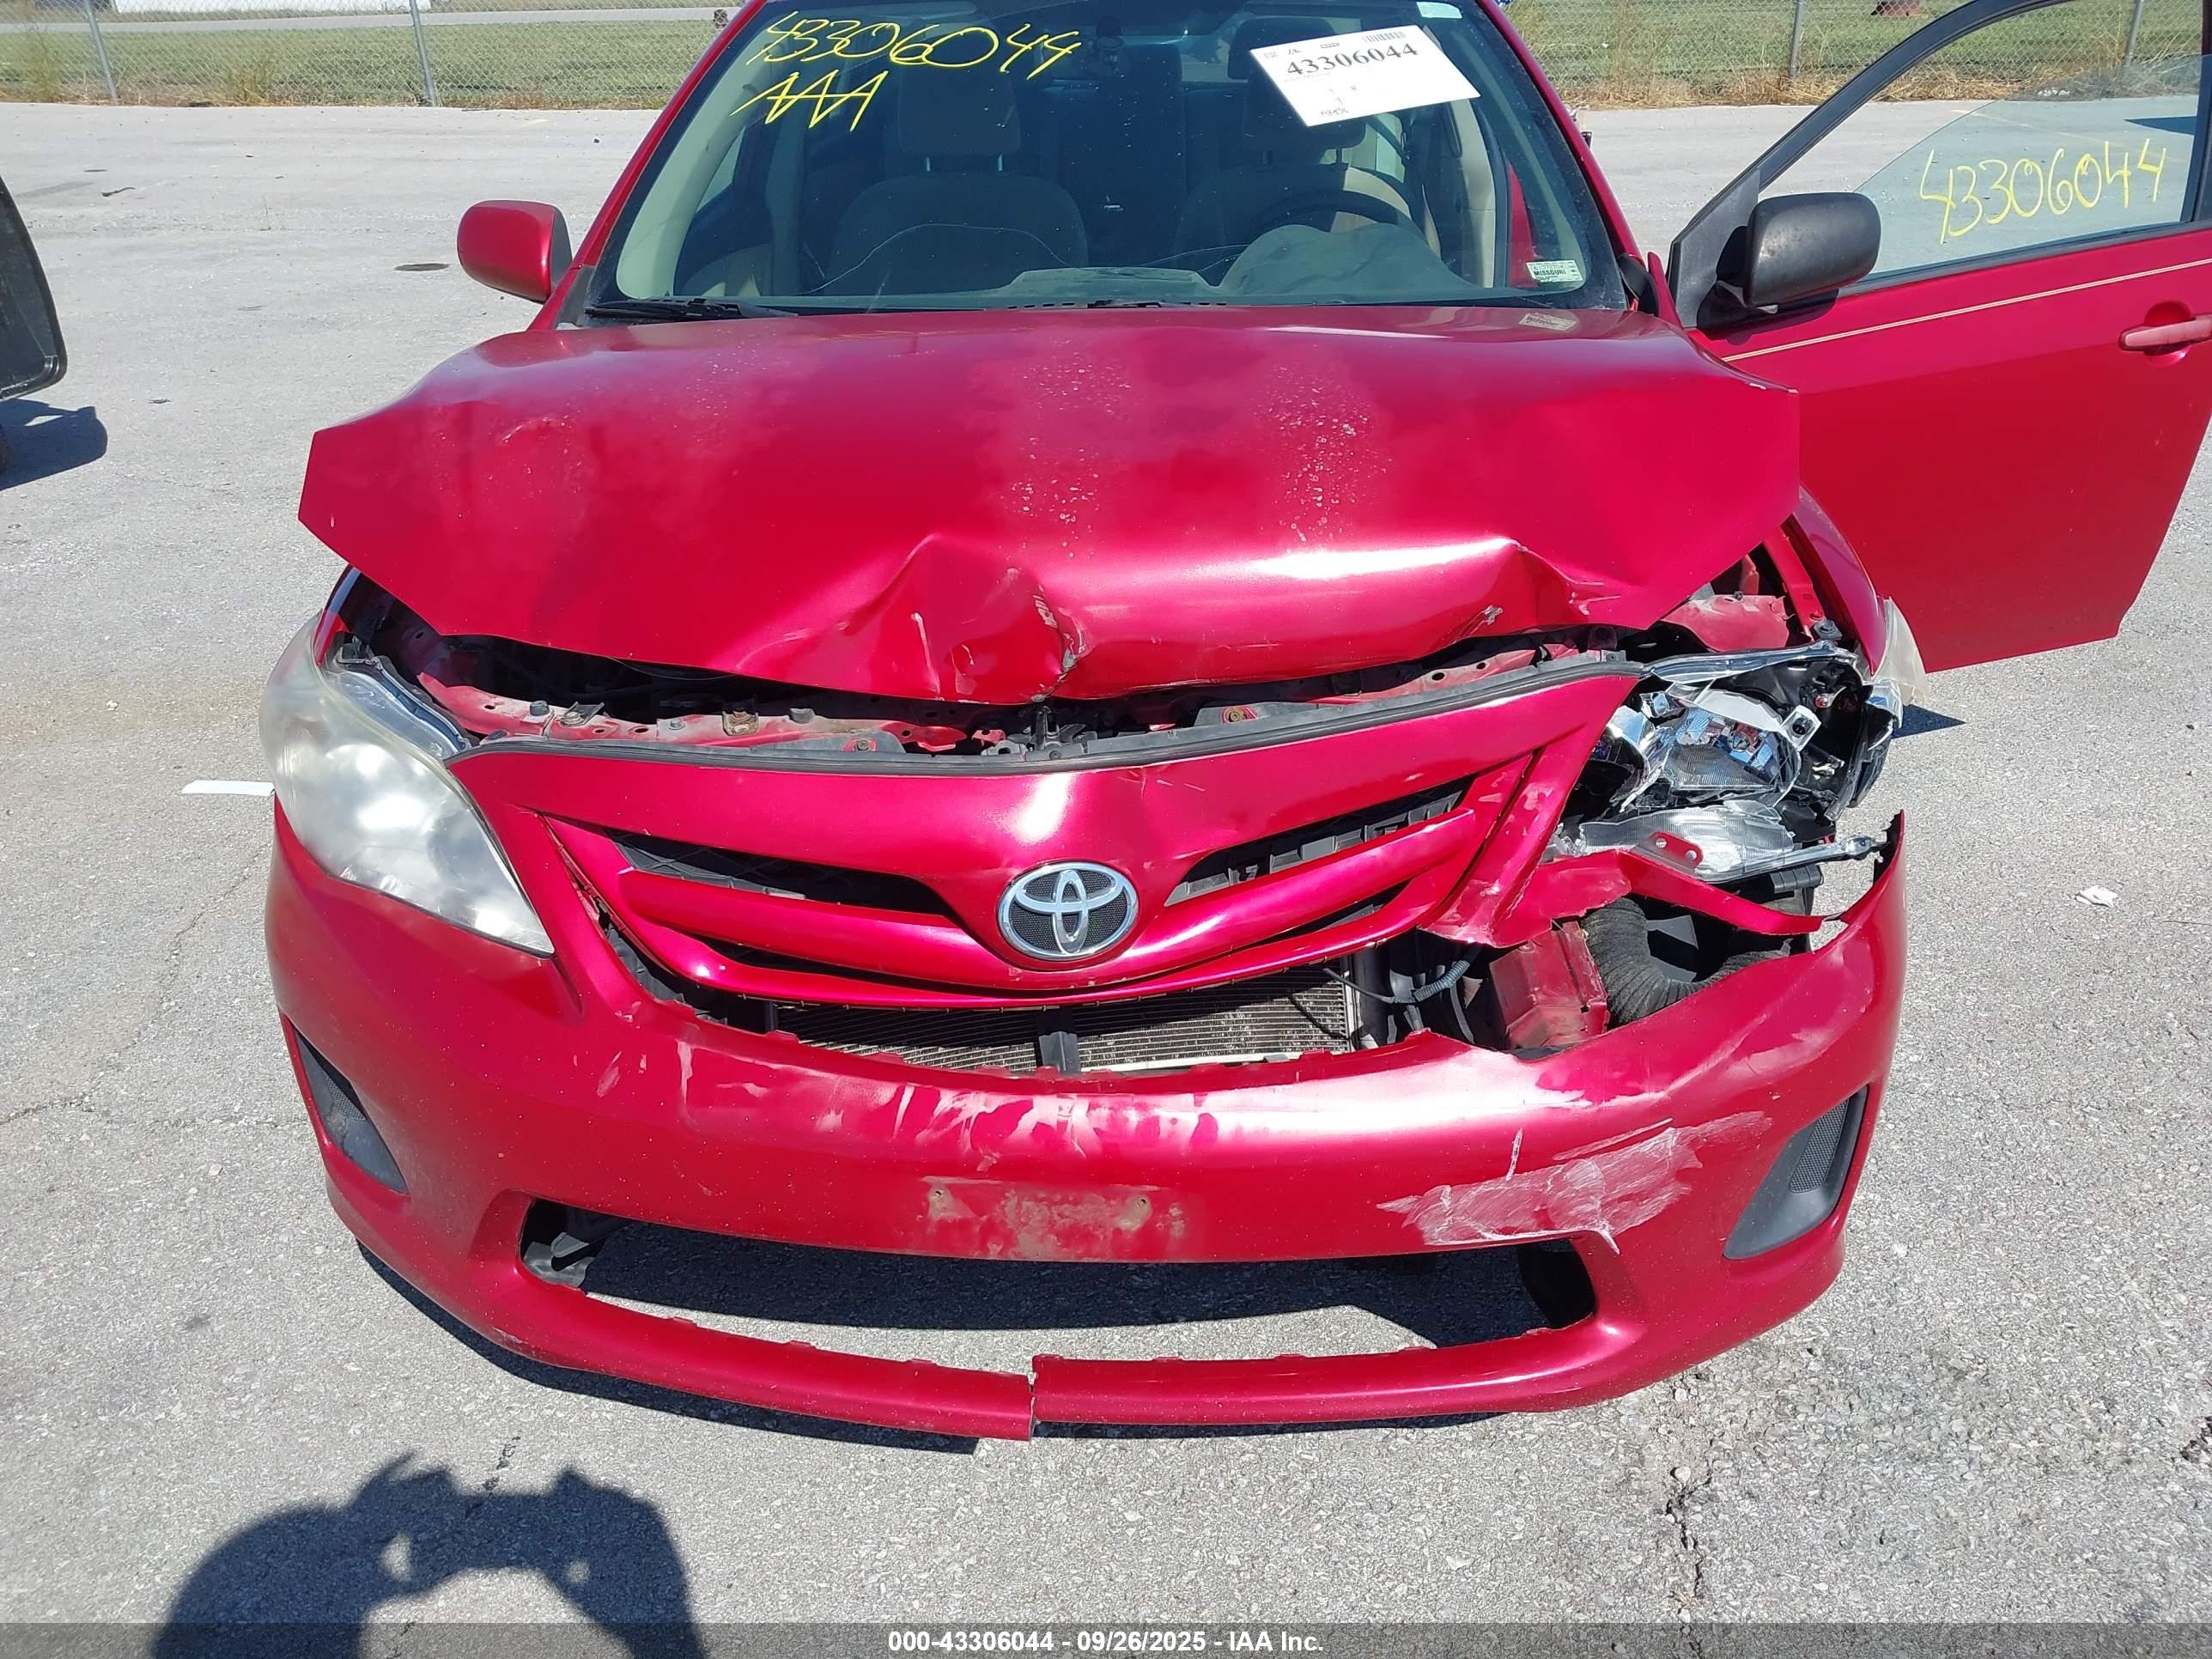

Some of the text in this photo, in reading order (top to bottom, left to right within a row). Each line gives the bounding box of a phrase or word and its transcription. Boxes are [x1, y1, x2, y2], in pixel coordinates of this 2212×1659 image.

[745, 11, 1083, 80] 43306044
[1286, 43, 1419, 76] 43306044
[1920, 138, 2167, 245] 43306044
